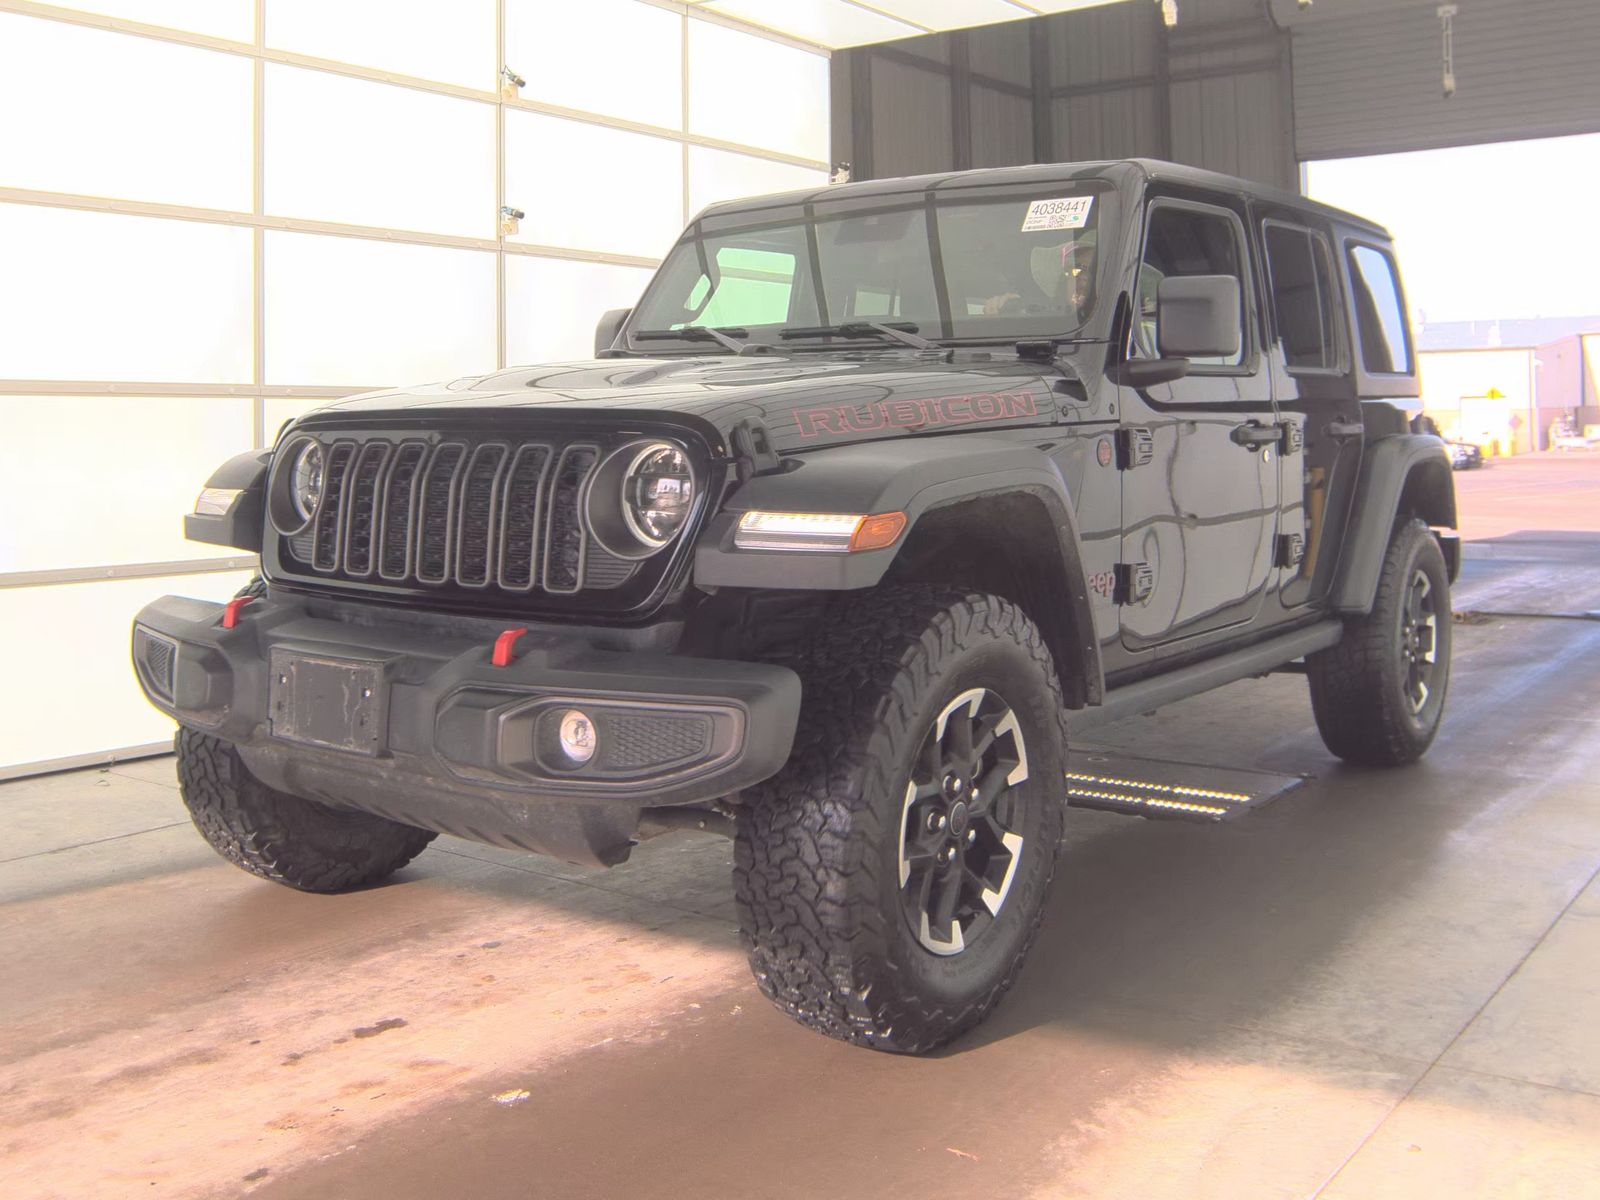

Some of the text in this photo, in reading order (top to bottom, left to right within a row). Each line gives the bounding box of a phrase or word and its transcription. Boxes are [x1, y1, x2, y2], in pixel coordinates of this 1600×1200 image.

[1031, 200, 1087, 216] 4038441
[793, 391, 1038, 437] RUBICON
[1088, 571, 1116, 598] eep
